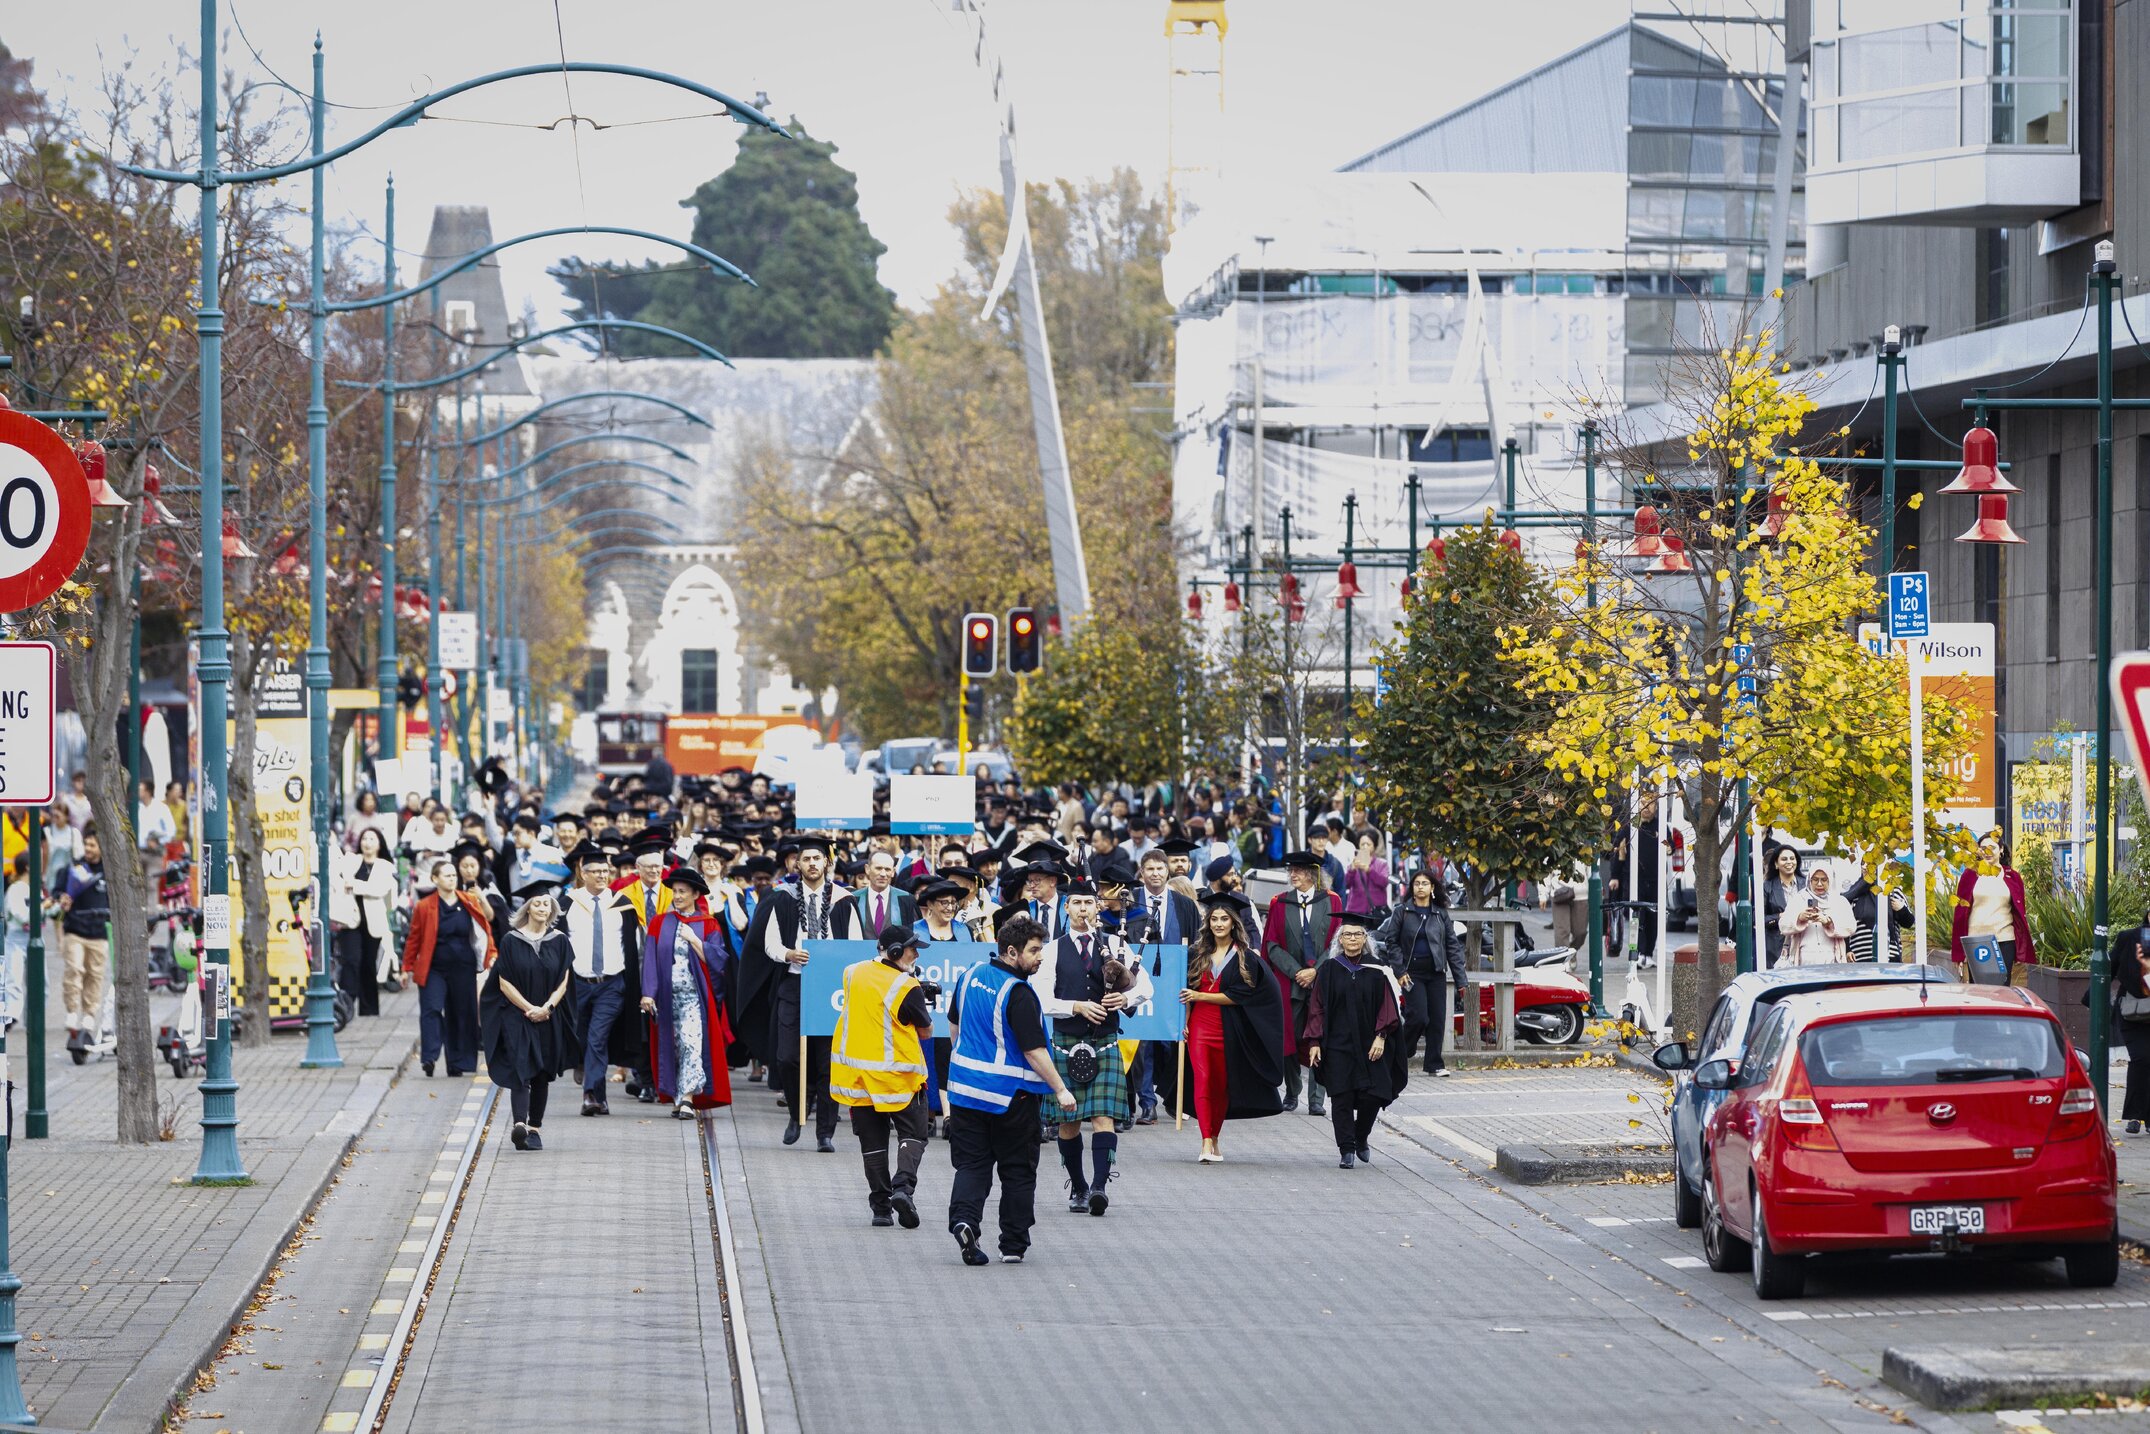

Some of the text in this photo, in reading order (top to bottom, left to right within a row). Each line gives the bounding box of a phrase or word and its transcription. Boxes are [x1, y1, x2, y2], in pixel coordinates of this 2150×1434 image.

[1900, 597, 1918, 611] 120
[1912, 620, 1925, 628] 6pm
[1919, 642, 1982, 658] Wilson
[2, 690, 29, 719] NG
[1978, 948, 1988, 960] P
